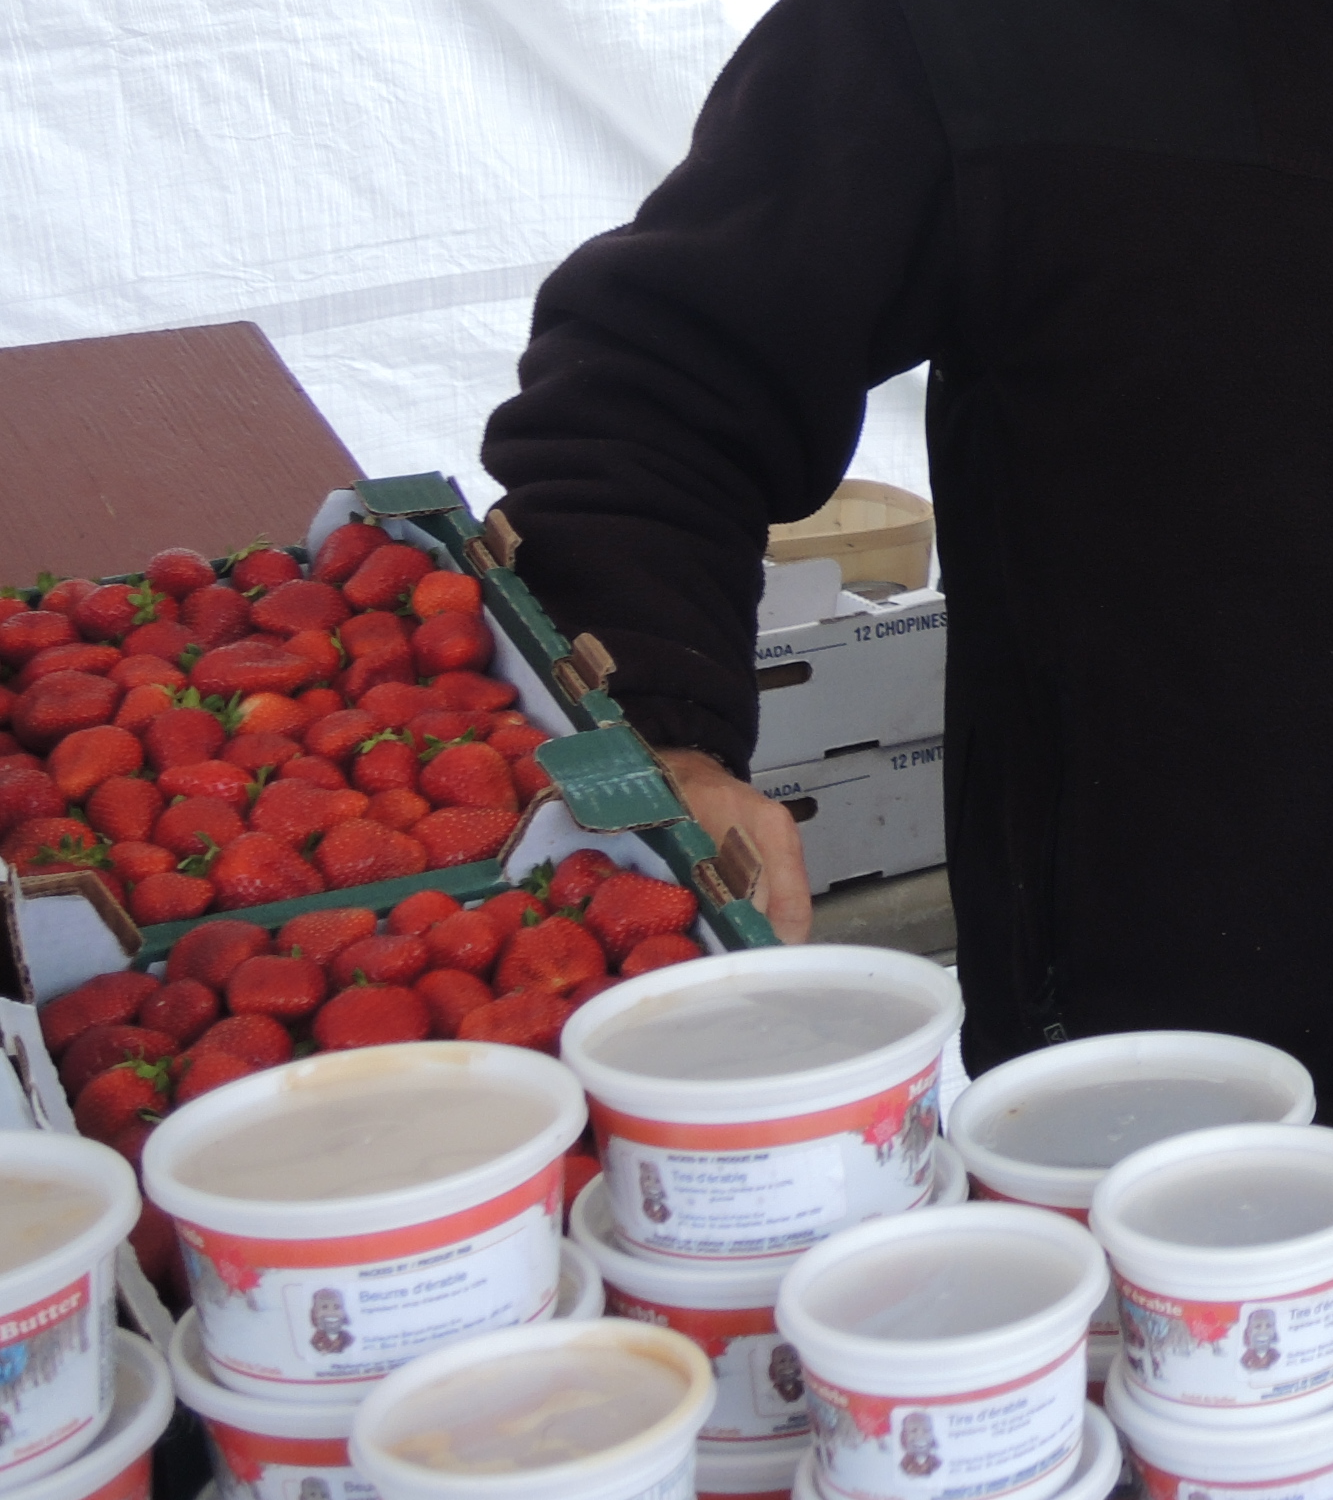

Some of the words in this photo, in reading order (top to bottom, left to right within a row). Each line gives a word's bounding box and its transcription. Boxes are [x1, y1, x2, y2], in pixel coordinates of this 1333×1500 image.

[854, 625, 872, 642] 12
[876, 611, 948, 639] CHOPINES
[890, 755, 907, 770] 12
[359, 1288, 408, 1303] Beurre
[412, 1272, 468, 1295] d'érable
[1, 1291, 83, 1340] Butter
[1289, 1307, 1311, 1321] Tire
[947, 1414, 974, 1427] Tire
[976, 1397, 1029, 1423] d'érable
